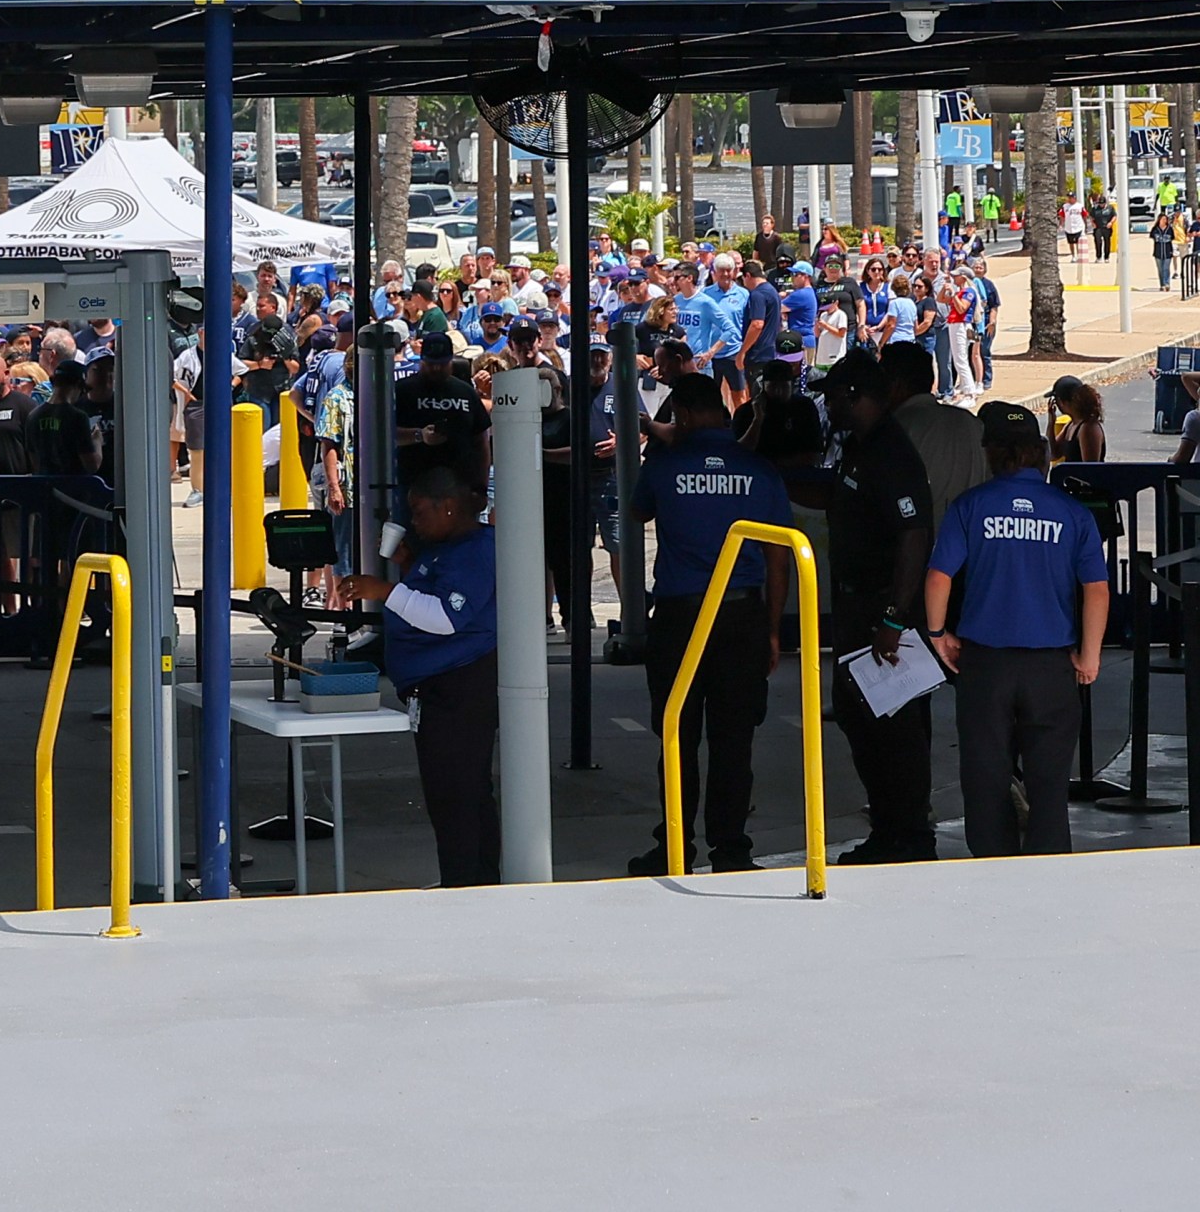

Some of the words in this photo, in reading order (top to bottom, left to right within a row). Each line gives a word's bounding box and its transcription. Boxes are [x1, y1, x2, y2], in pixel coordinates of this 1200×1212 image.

[950, 125, 982, 158] TB
[27, 188, 139, 232] 10
[678, 314, 700, 327] UBS
[676, 474, 753, 496] SECURITY
[984, 516, 1063, 544] SECURITY
